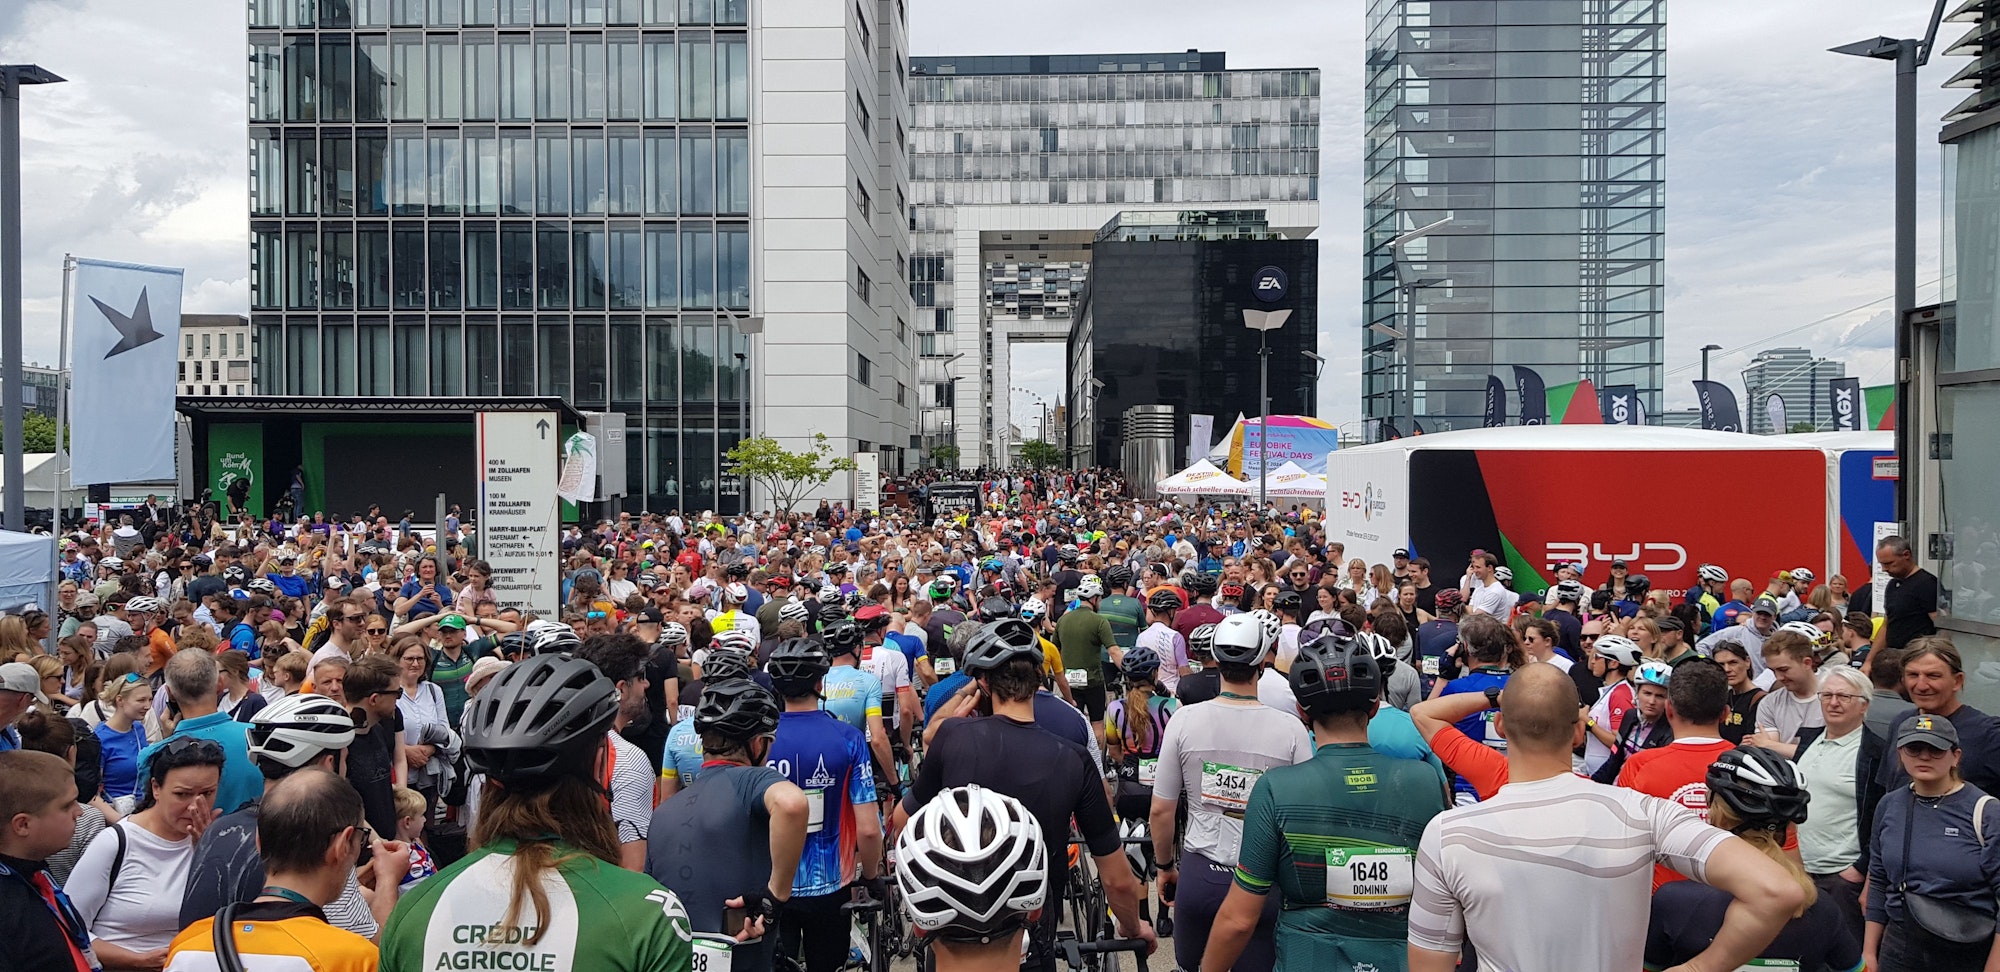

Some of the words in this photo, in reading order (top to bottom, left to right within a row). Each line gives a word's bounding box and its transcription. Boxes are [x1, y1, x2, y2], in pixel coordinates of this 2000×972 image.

[1258, 277, 1281, 289] EA
[1250, 442, 1292, 450] EUOBIKE
[1216, 774, 1246, 790] 3454
[1222, 790, 1240, 799] SIMON
[1350, 861, 1388, 881] 1648
[1353, 885, 1388, 895] DOMINIK
[435, 951, 556, 972] AGRICOLE
